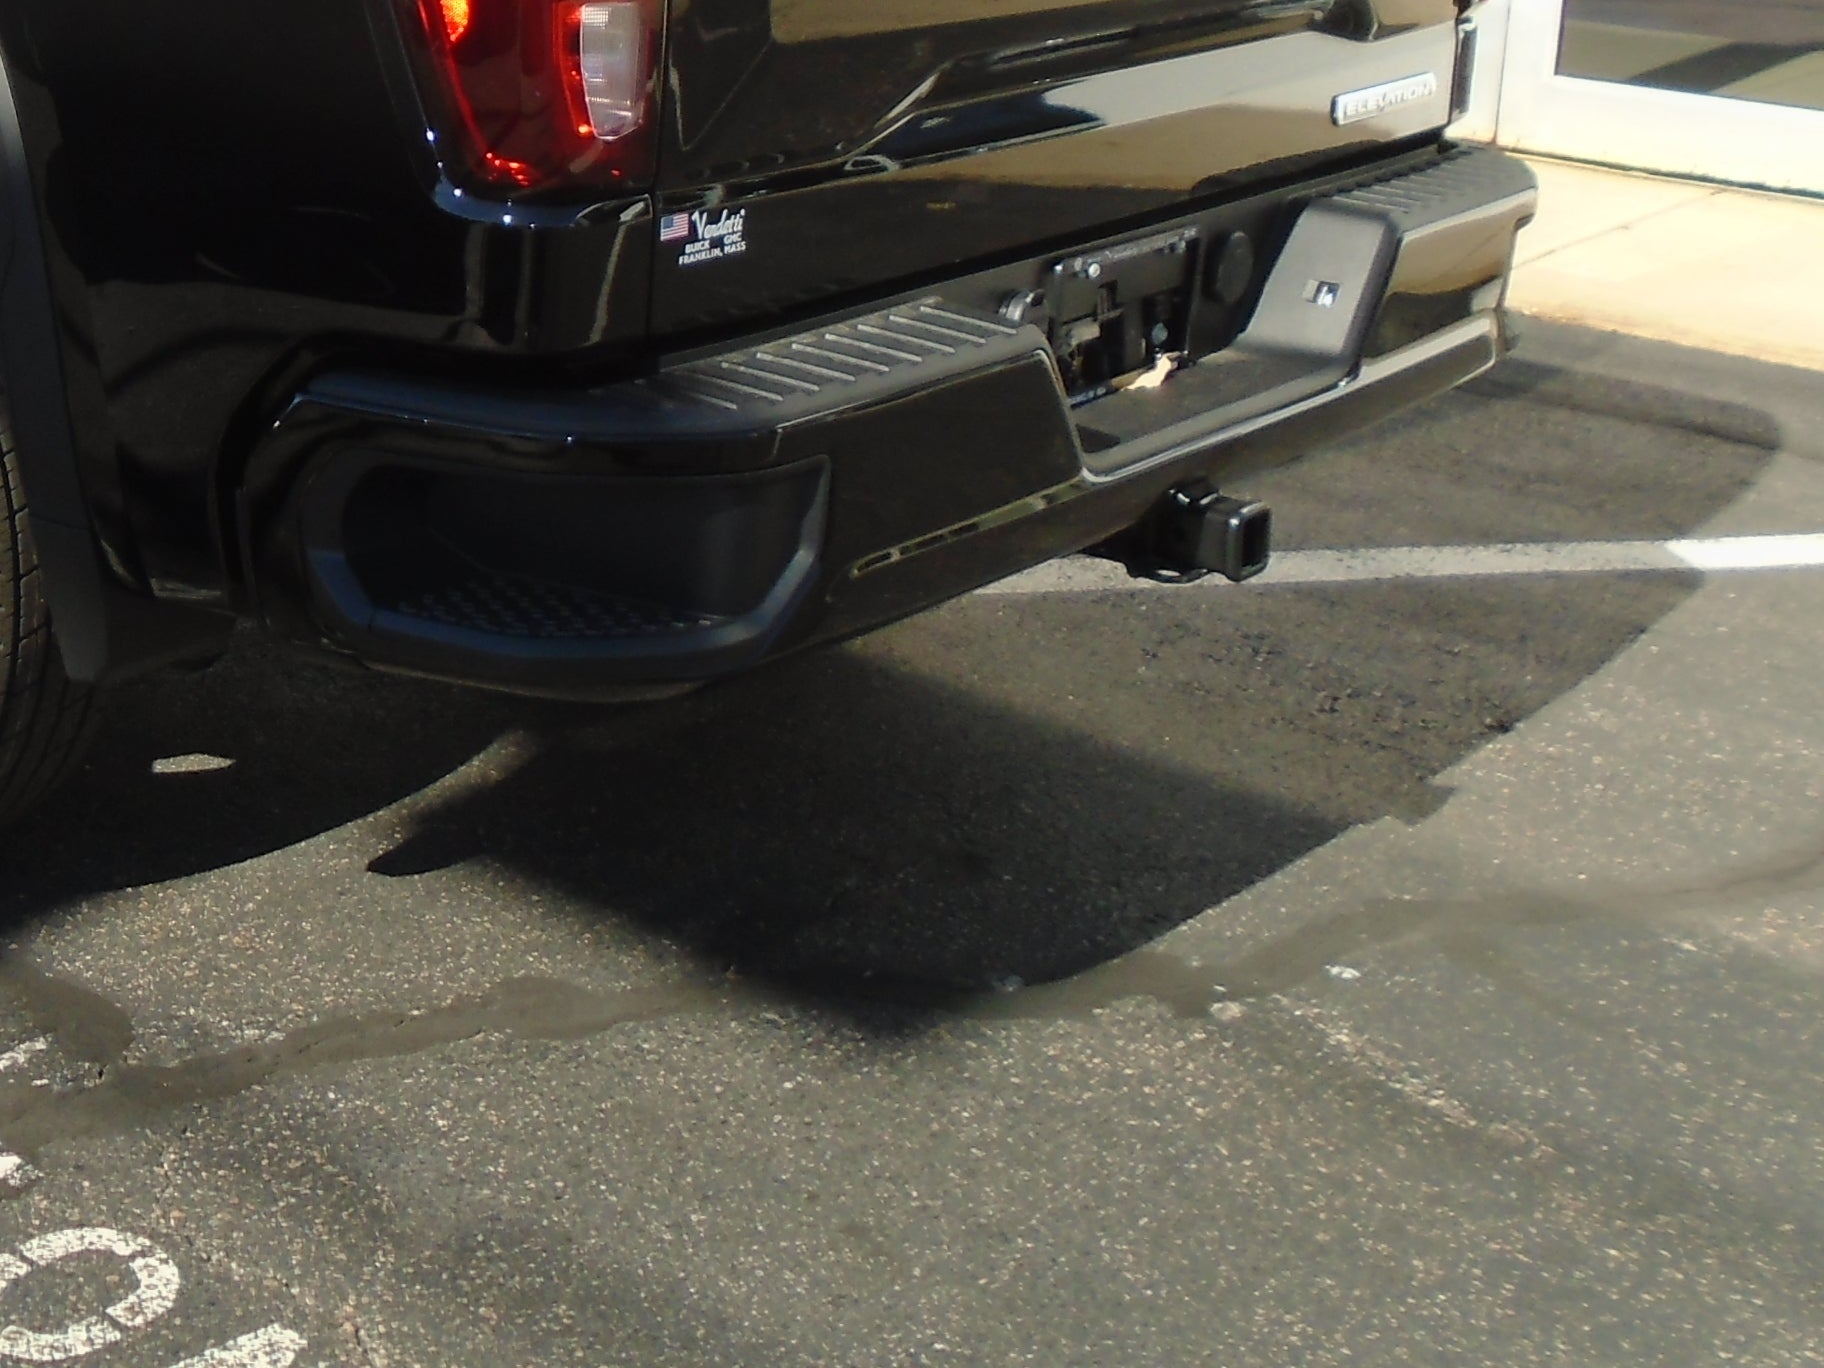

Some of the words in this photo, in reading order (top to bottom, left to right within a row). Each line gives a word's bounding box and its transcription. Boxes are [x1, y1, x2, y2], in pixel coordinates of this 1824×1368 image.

[1343, 82, 1433, 120] ELEVATION
[679, 248, 723, 265] FRANKLIN,
[724, 241, 746, 254] MASS
[685, 240, 710, 253] BUICK
[724, 233, 742, 244] GMC
